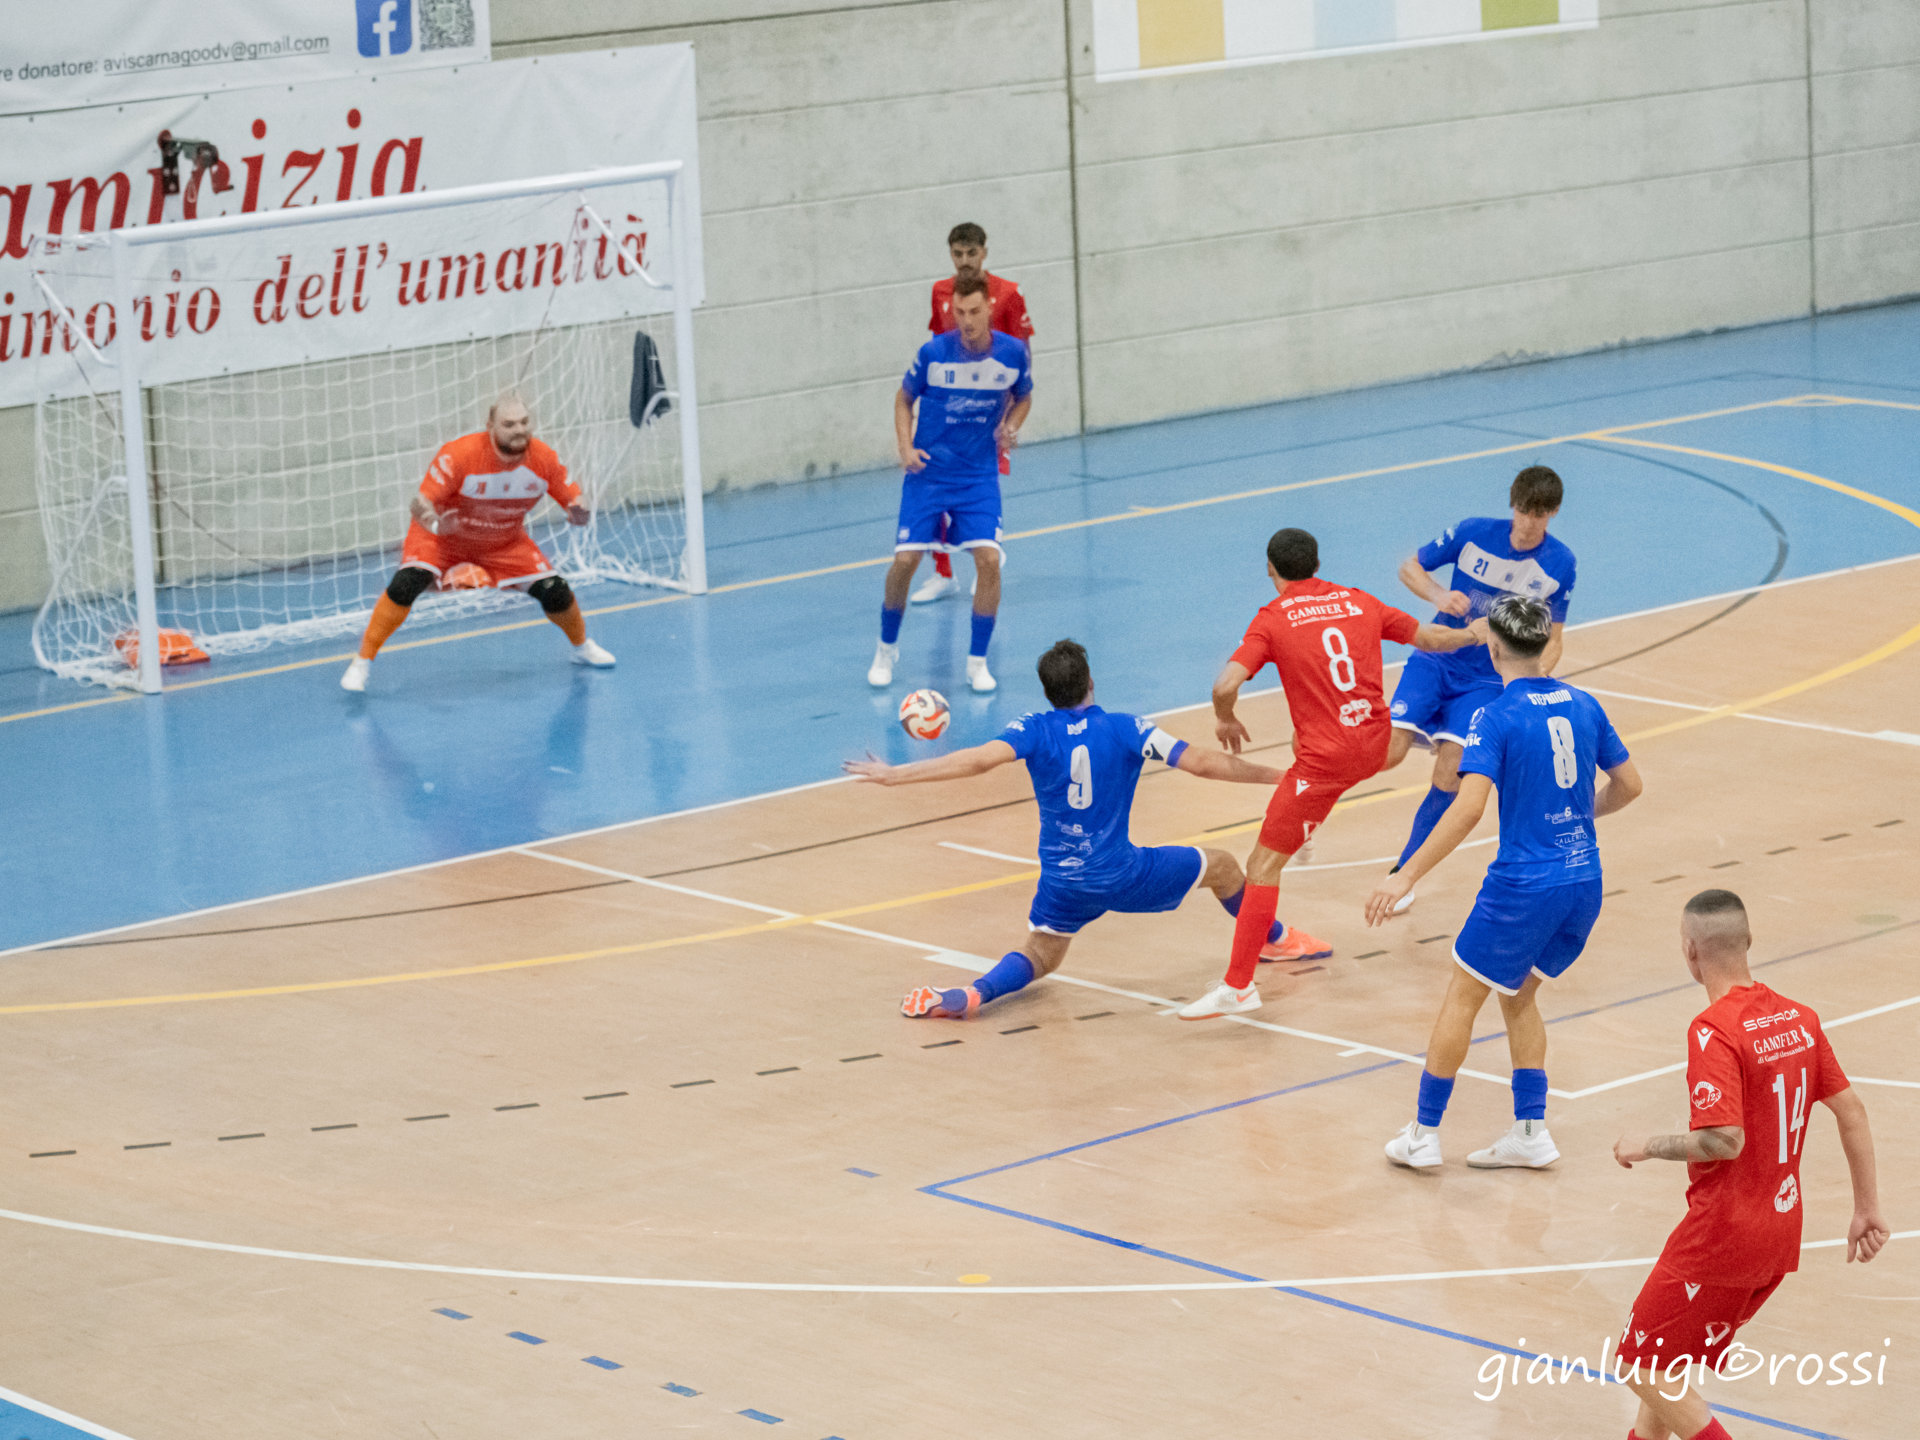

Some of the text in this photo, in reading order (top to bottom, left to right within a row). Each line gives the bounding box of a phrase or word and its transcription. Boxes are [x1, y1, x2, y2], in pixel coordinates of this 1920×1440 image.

[18, 60, 98, 81] donatore:
[104, 36, 329, 74] aviscarnagoodv@gmail.com
[1473, 558, 1490, 576] 21
[1287, 603, 1343, 621] GAMIFER
[1322, 627, 1357, 692] 8
[1067, 744, 1093, 810] 9
[1547, 716, 1578, 789] 8
[1753, 1030, 1802, 1054] GAMIFER
[1772, 1067, 1807, 1164] 14
